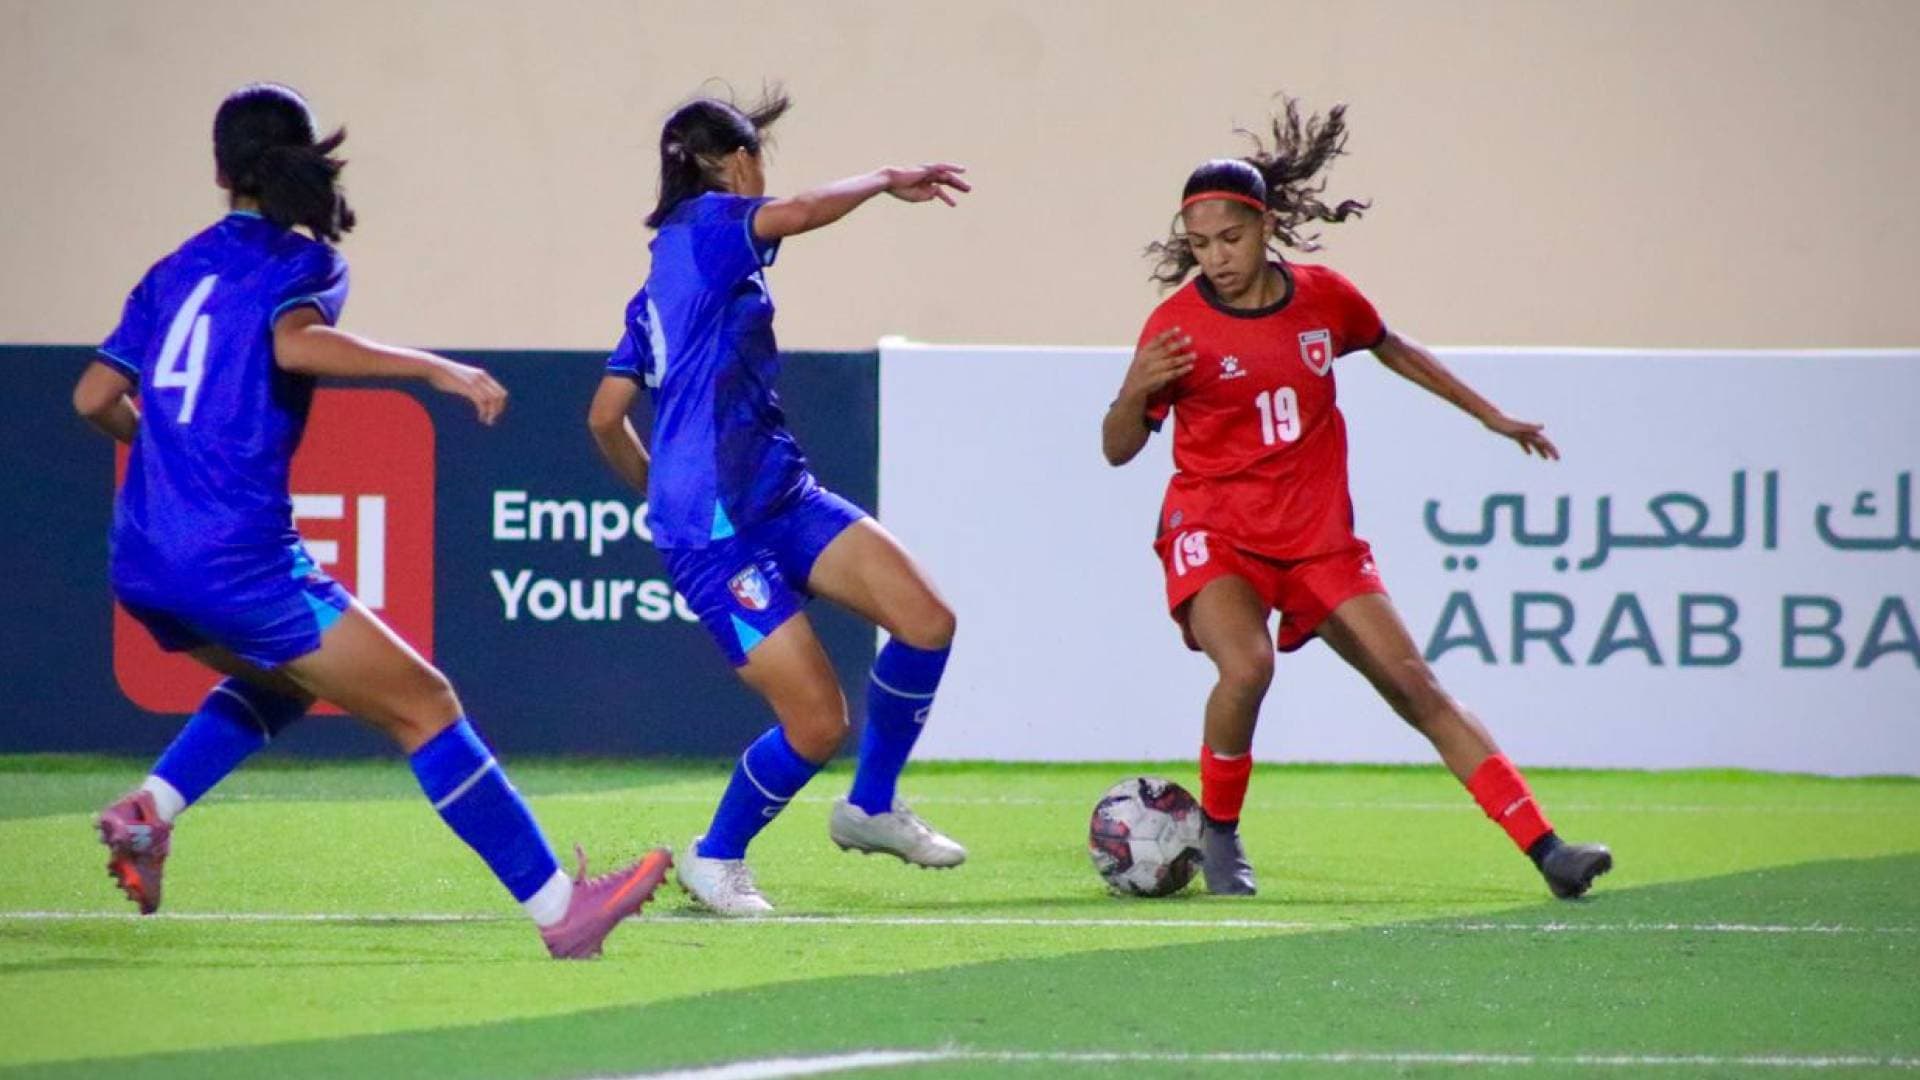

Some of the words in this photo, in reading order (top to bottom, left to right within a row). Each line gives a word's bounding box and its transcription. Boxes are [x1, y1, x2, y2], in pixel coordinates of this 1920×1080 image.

[153, 273, 218, 424] 4
[1255, 386, 1301, 446] 19
[1174, 530, 1209, 577] 19
[1423, 470, 1779, 571] العربي
[1424, 591, 1742, 667] ARAB
[1782, 594, 1920, 669] BA
